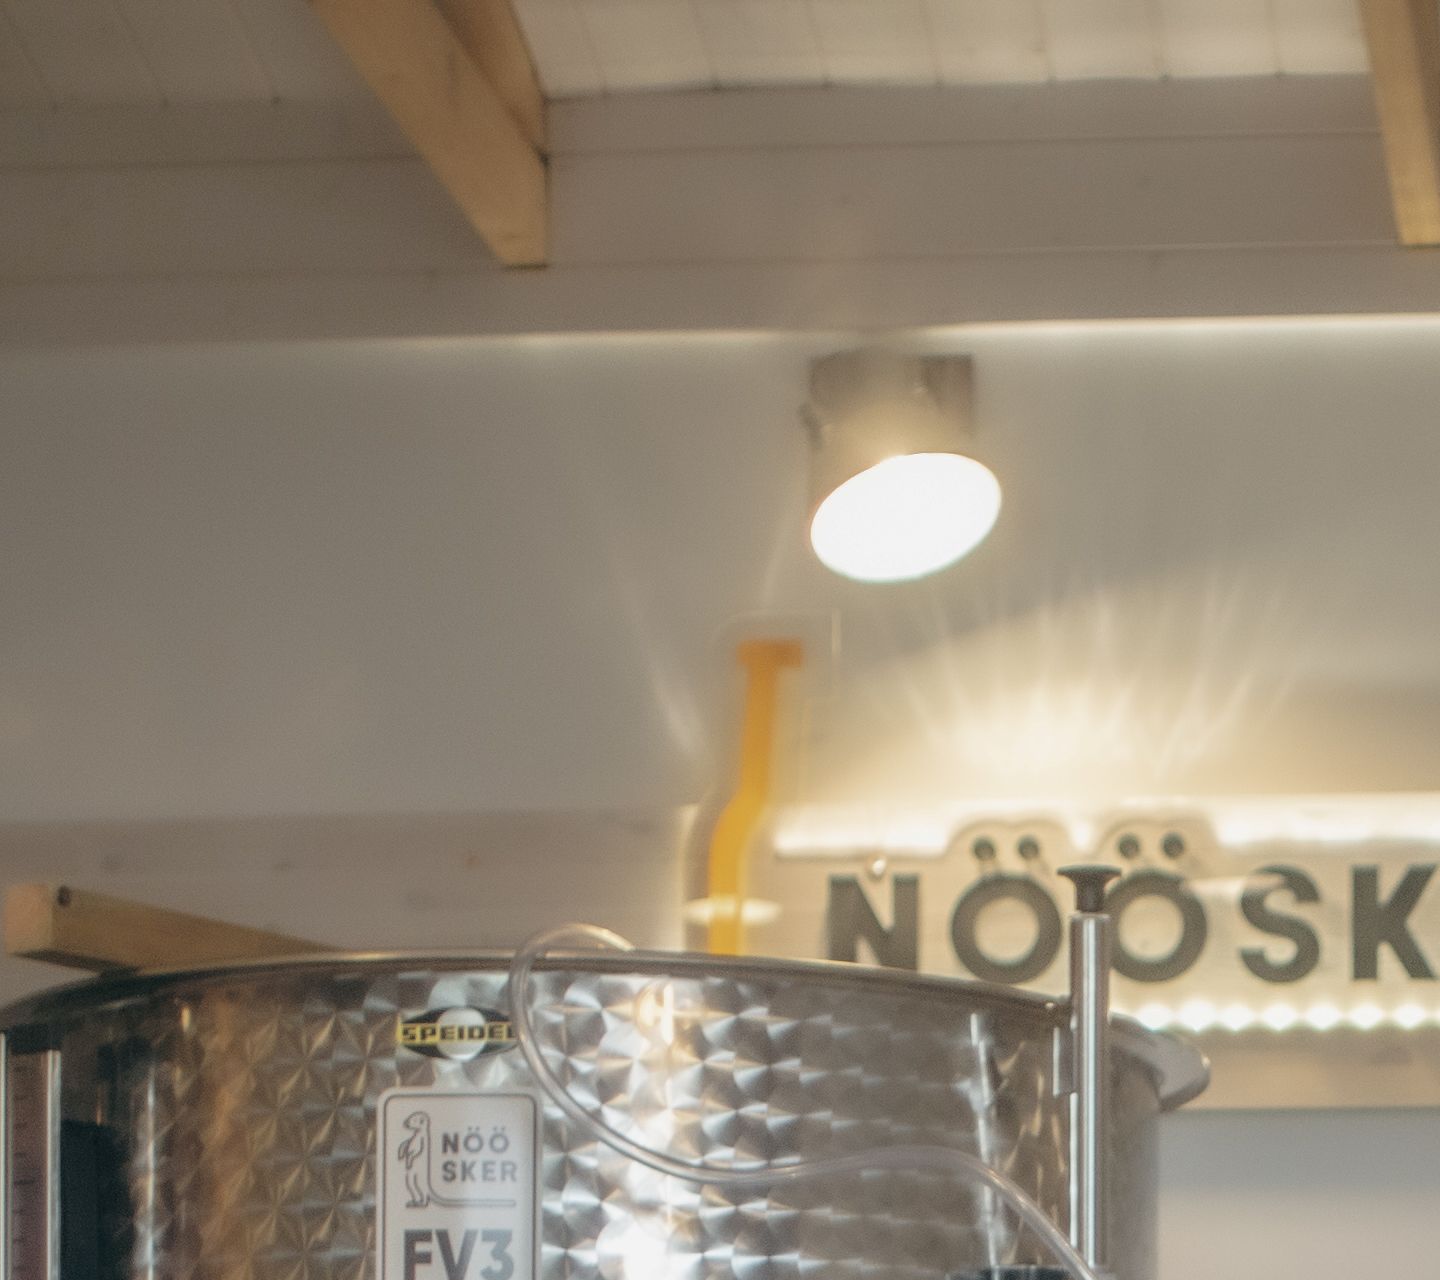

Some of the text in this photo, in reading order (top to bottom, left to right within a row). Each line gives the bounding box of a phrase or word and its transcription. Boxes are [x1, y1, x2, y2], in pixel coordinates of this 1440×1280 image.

[401, 1024, 517, 1040] SPEIDEL
[441, 1126, 510, 1154] NÖÖ
[441, 1161, 518, 1184] SKER
